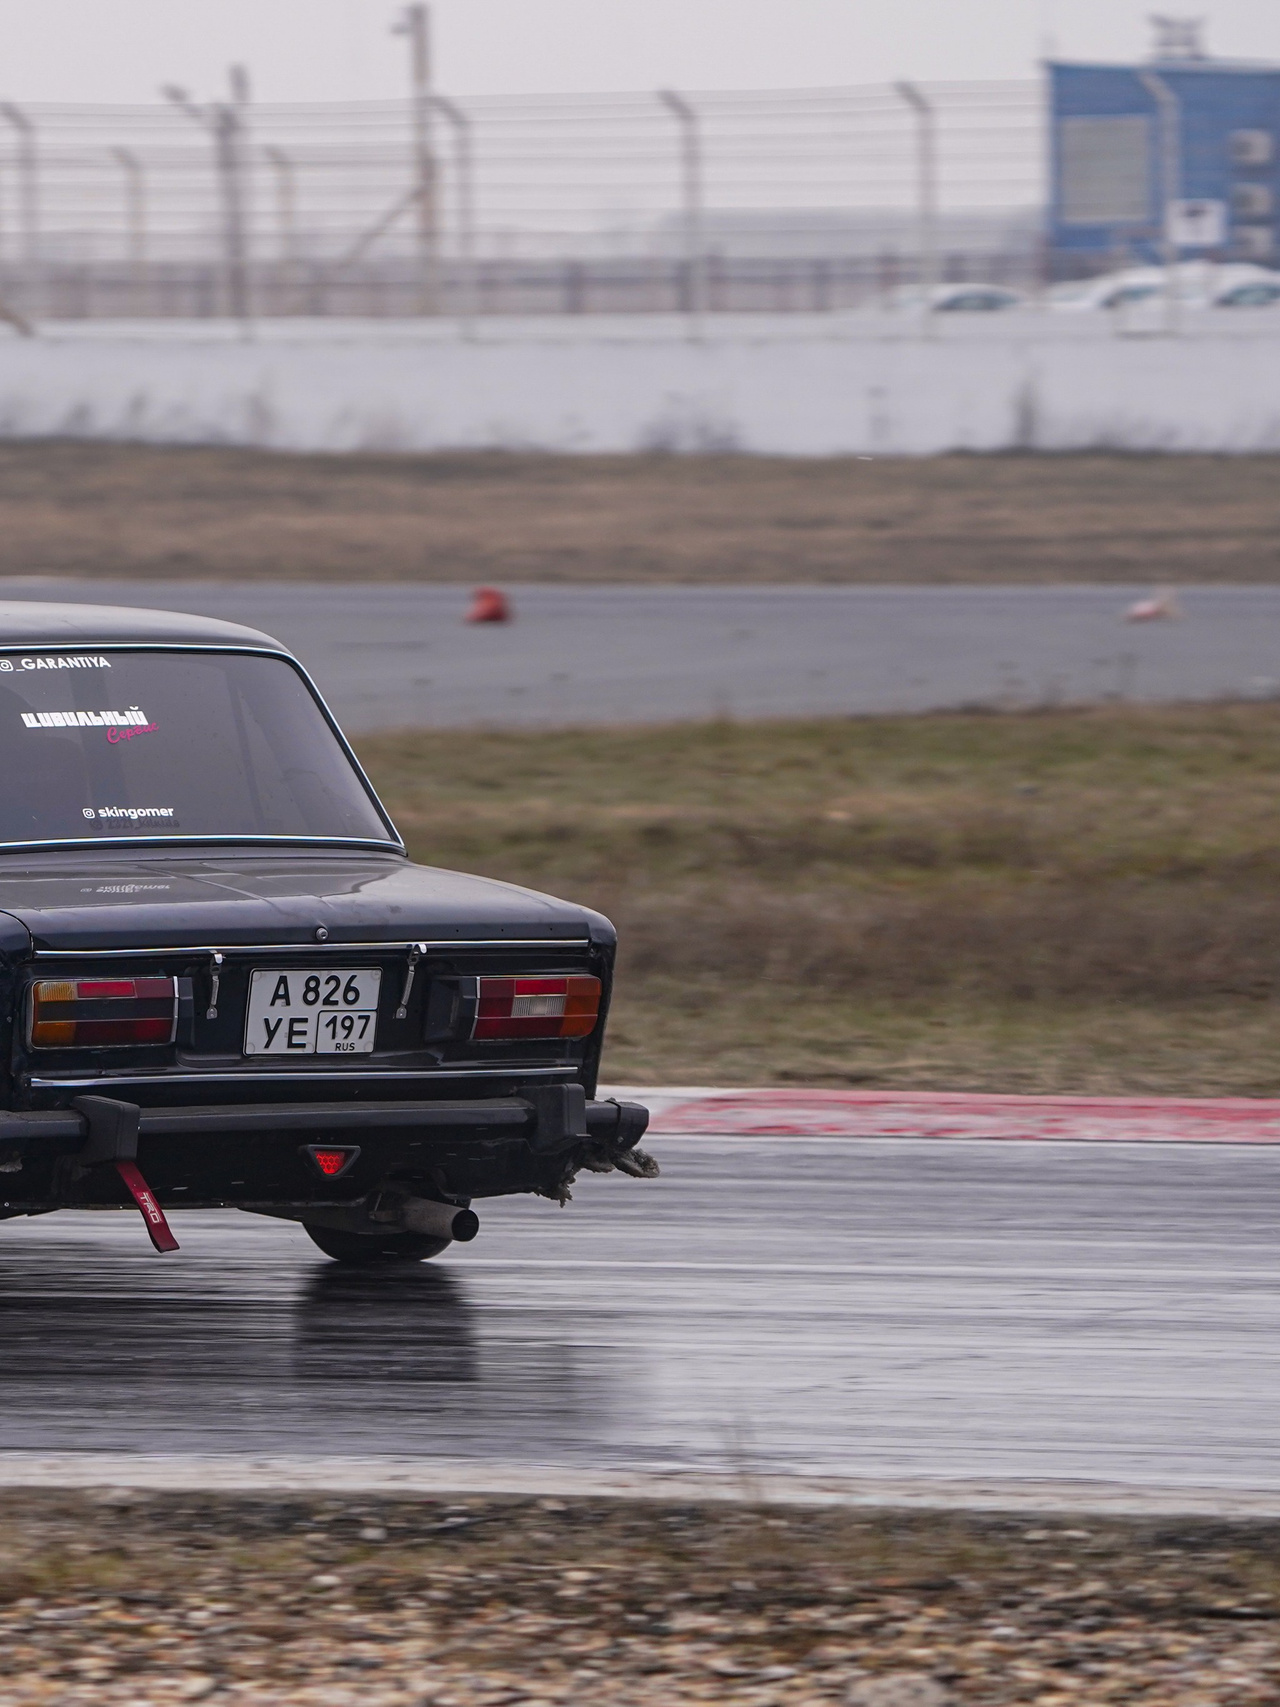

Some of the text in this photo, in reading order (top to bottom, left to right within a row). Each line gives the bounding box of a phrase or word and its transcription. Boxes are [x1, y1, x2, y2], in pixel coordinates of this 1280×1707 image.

[98, 806, 174, 819] skingomer
[302, 974, 360, 1006] 826
[325, 1014, 371, 1040] 197
[334, 1042, 356, 1051] RUS
[140, 1192, 161, 1224] TRD
